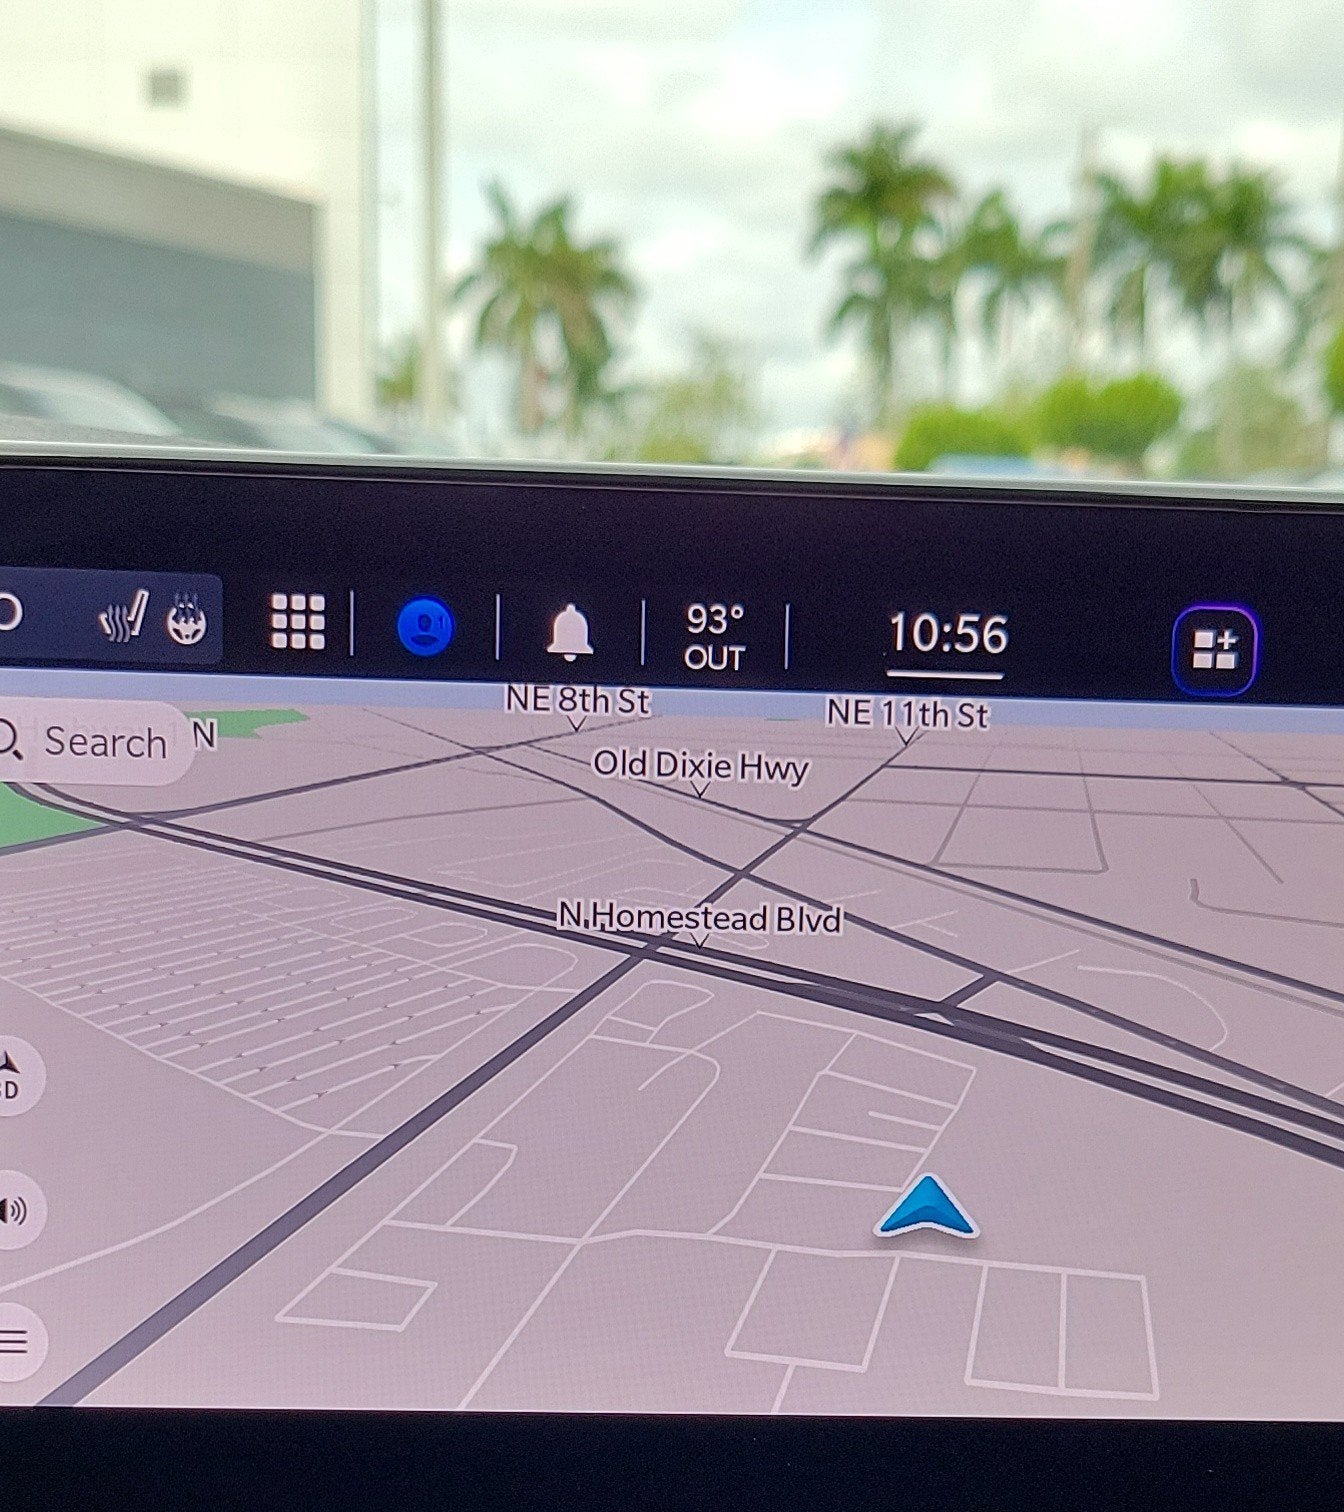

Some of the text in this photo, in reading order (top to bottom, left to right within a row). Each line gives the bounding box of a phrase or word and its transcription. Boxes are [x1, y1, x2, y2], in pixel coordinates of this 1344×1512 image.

[686, 603, 745, 635] 93°
[890, 612, 1010, 655] 10:56
[684, 644, 747, 672] OUT
[507, 684, 650, 714] NE 8th St
[827, 698, 989, 729] NE 11th St
[44, 726, 168, 759] Search
[192, 721, 215, 748] N
[593, 749, 811, 787] Old Dixie Hwy
[592, 902, 767, 931] Homestead
[777, 906, 842, 933] Blvd
